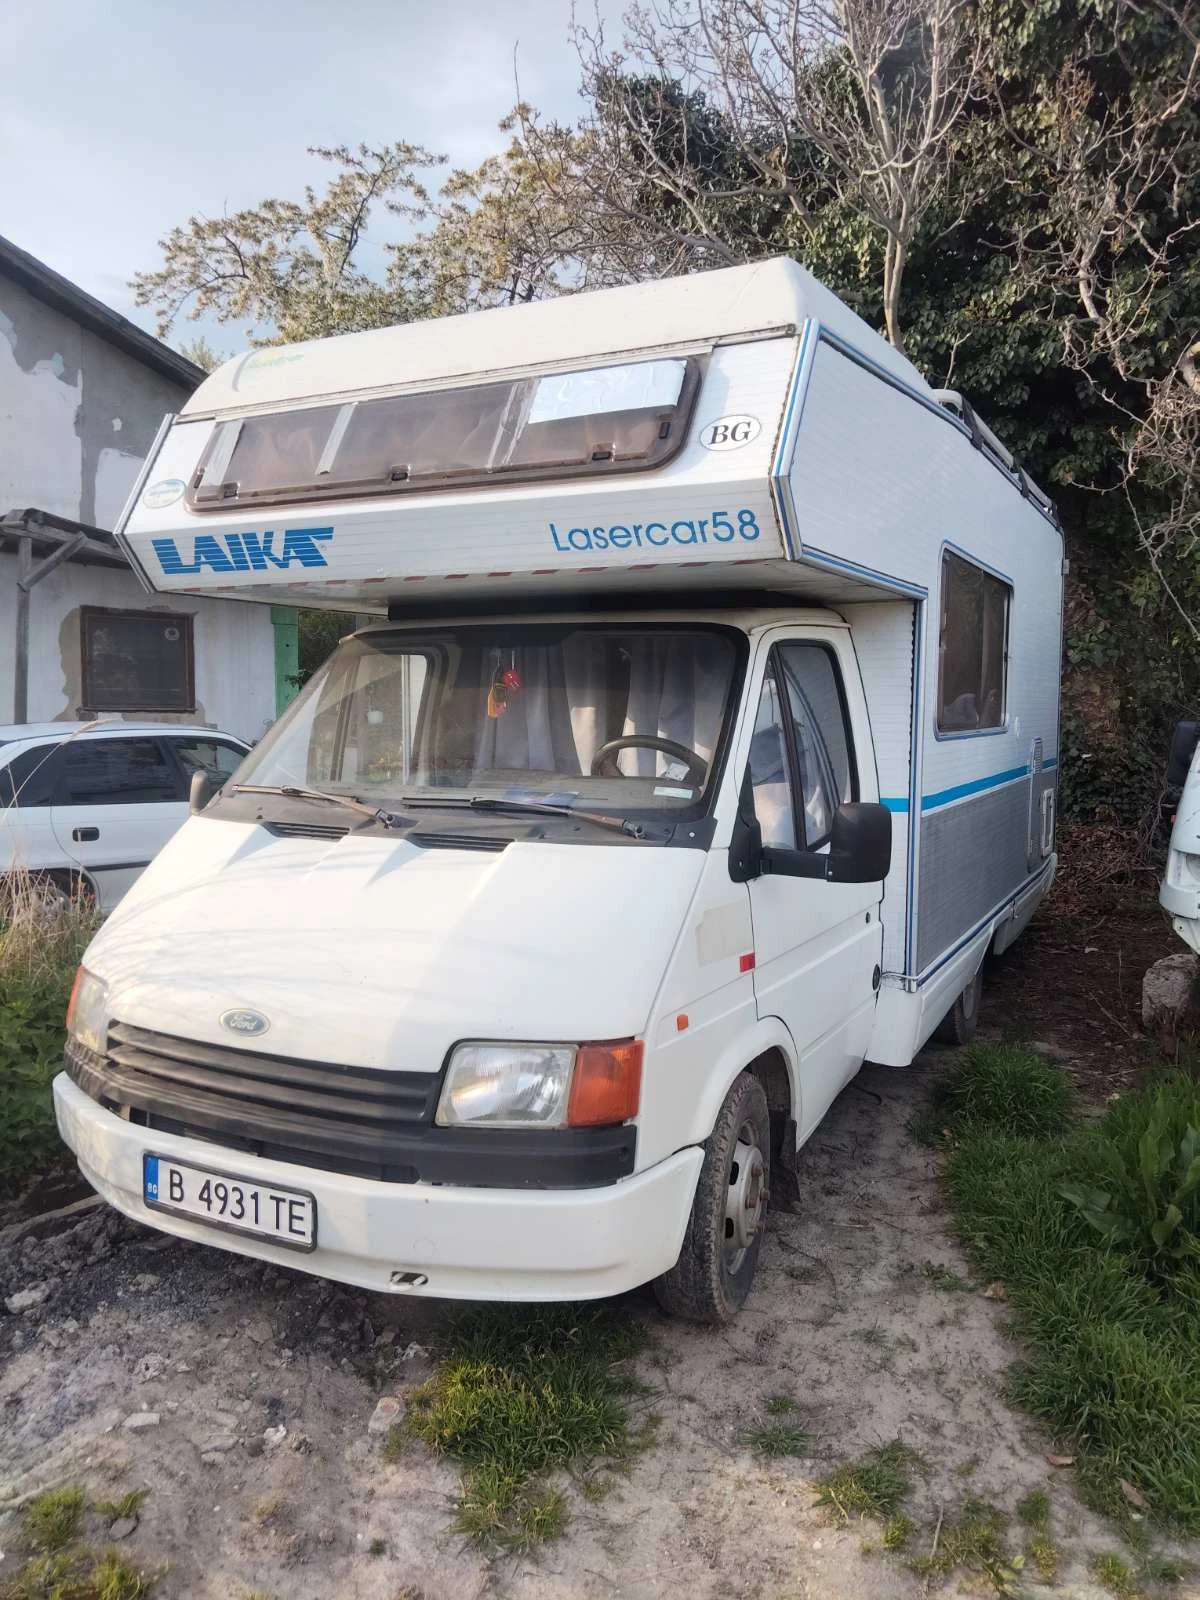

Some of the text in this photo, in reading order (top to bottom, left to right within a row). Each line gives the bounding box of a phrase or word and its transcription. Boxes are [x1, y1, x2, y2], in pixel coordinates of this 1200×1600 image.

[709, 420, 752, 445] BG
[151, 527, 335, 575] LAIKA
[549, 509, 760, 552] Lasercar58
[169, 1168, 306, 1237] B 4931 TE
